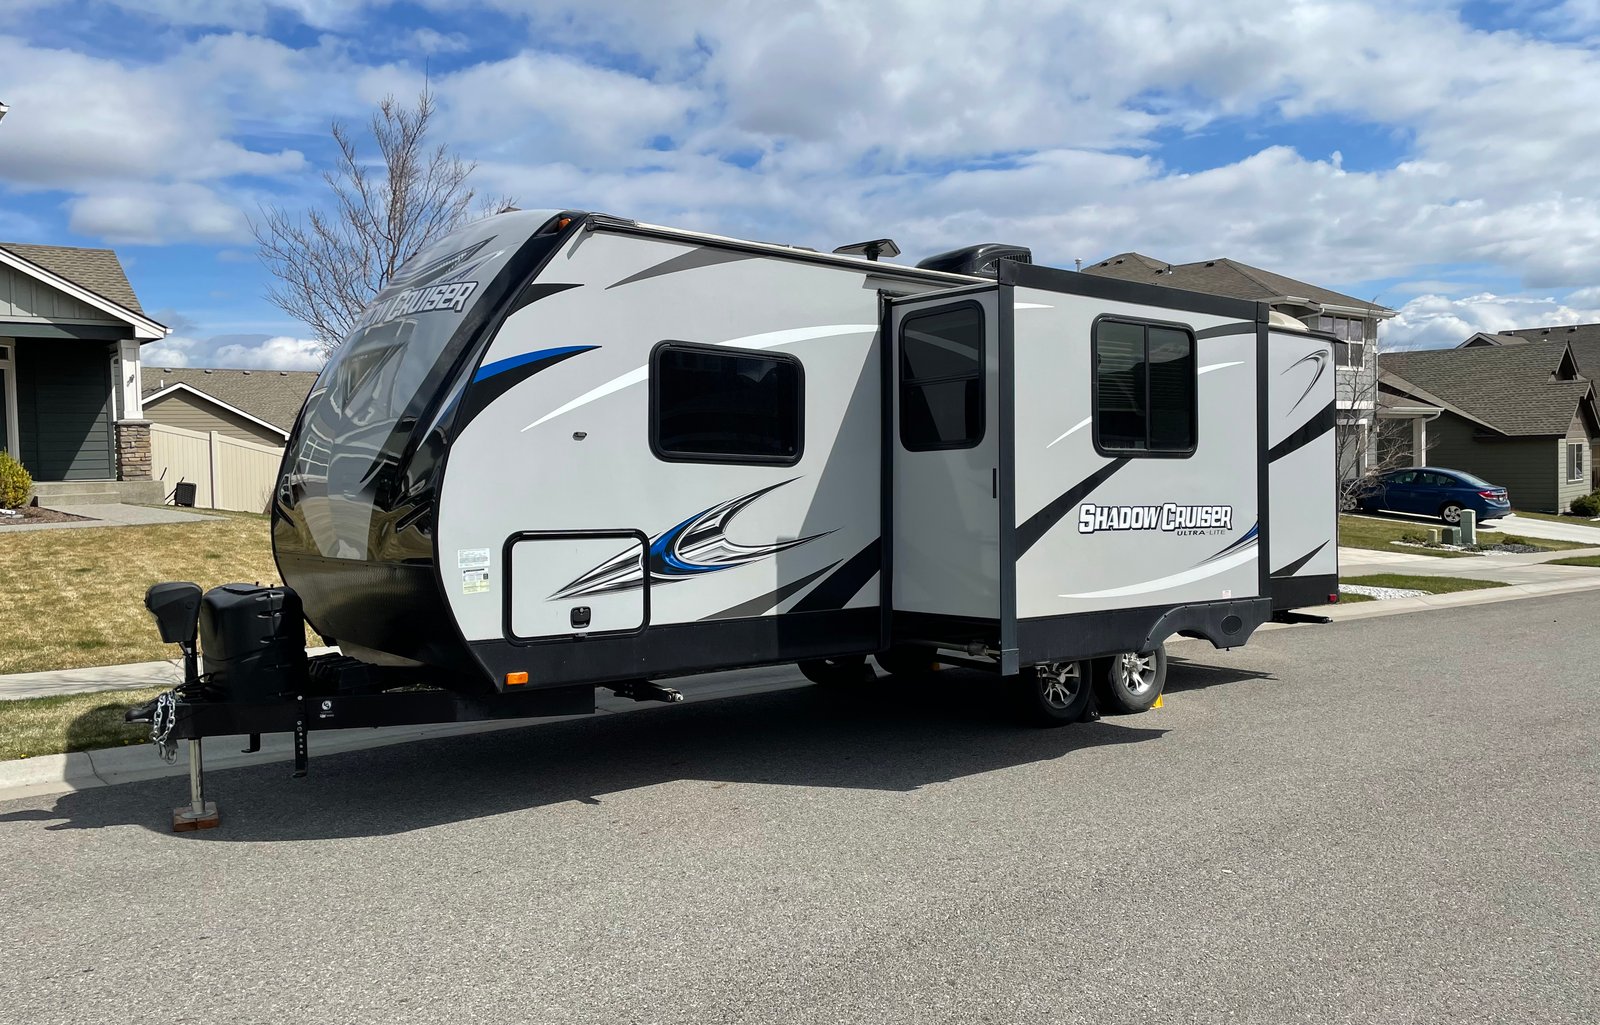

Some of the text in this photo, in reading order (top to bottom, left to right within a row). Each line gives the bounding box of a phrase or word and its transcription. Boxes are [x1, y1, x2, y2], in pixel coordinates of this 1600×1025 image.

[387, 281, 478, 321] CRUISER
[1078, 502, 1233, 534] SHADOW CRUISER
[1176, 529, 1226, 537] ULTRA-LITE
